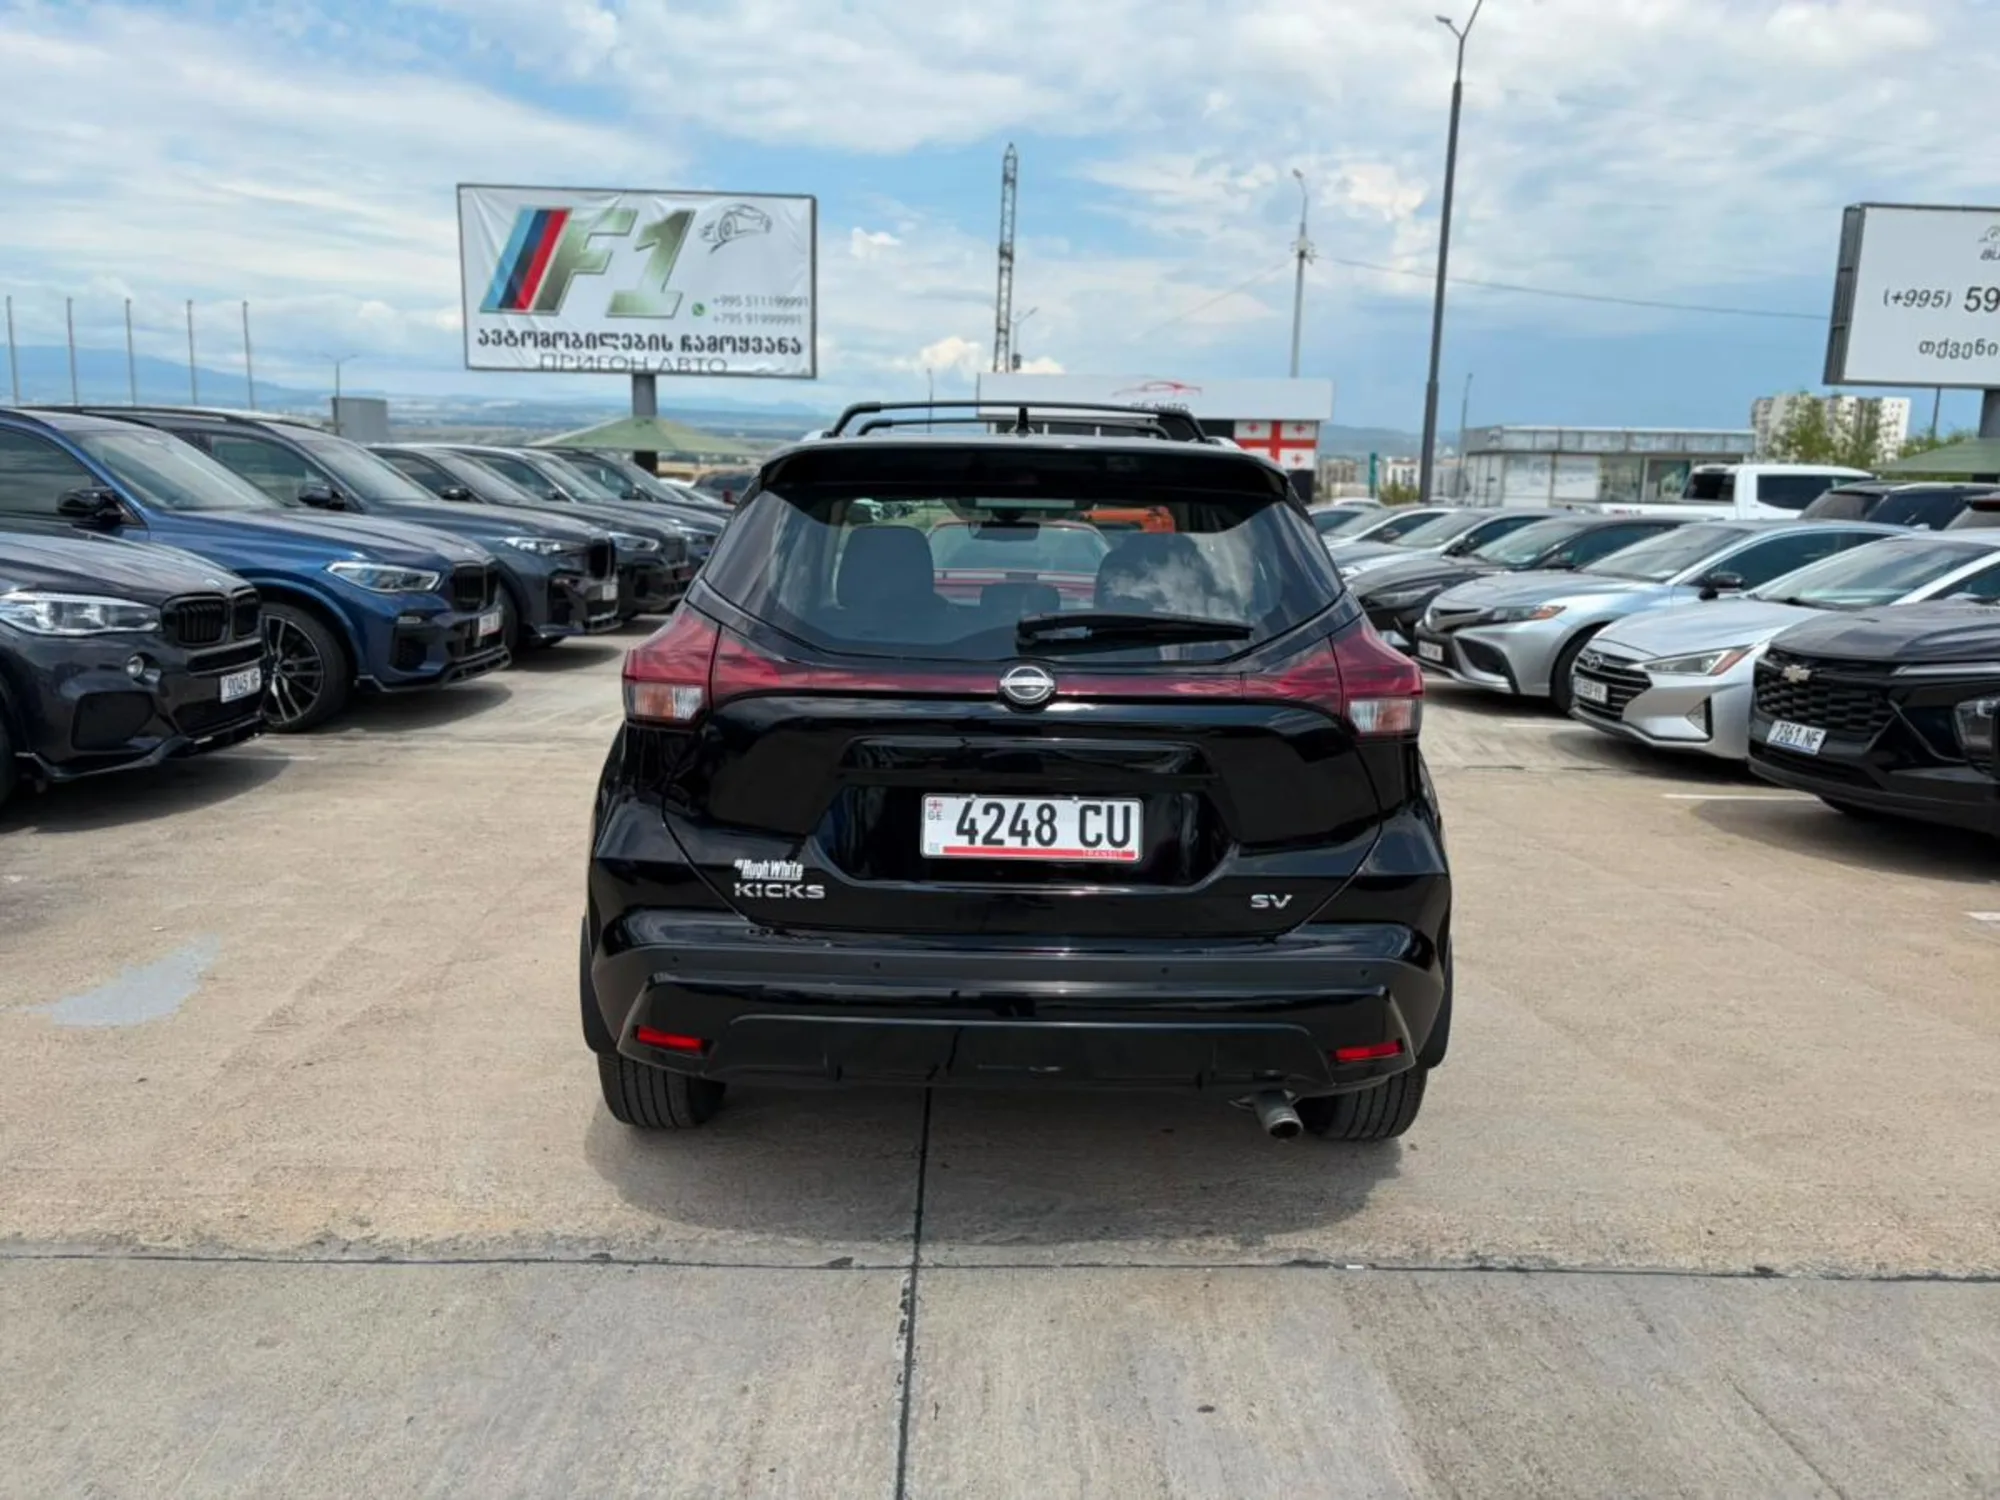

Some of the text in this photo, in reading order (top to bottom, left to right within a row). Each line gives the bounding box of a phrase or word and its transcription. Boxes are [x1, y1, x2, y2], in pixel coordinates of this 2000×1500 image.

[533, 206, 696, 319] F1
[1883, 287, 1952, 309] (+995)
[477, 328, 801, 355] ავტომობილების ჩამოყვანა
[540, 352, 728, 373] ПРИГОН АВТО
[955, 801, 1131, 848] 4248 CU
[771, 860, 804, 880] White
[733, 883, 826, 899] KICKS
[1250, 891, 1292, 902] SV
